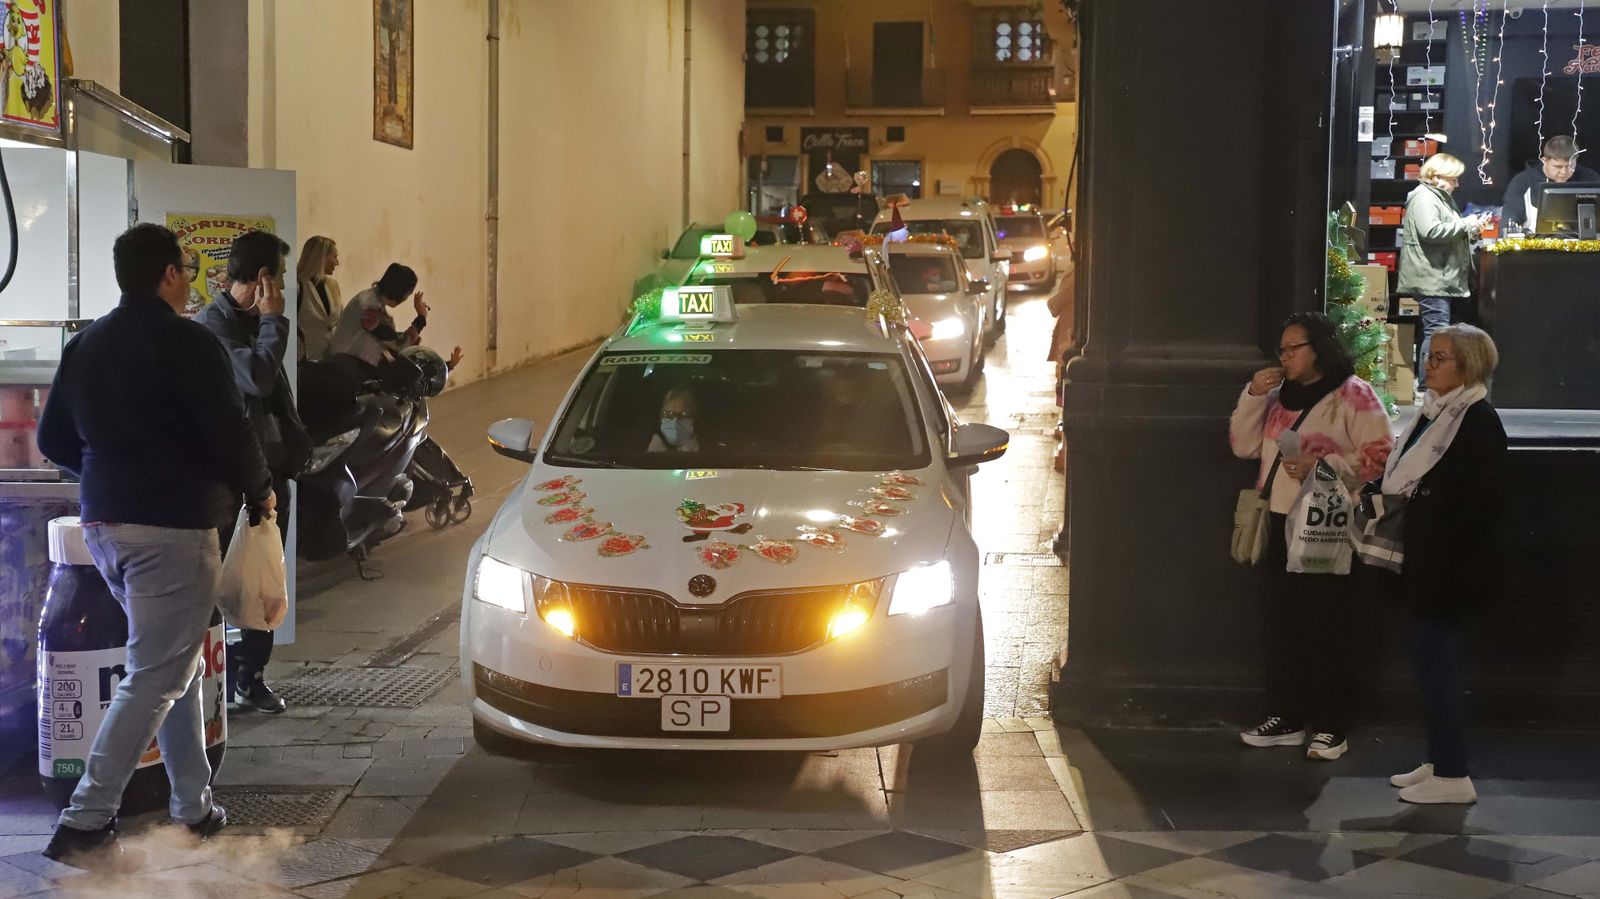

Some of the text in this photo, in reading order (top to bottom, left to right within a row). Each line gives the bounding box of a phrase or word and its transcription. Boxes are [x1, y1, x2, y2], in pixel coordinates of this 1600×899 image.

[712, 240, 732, 253] TAXI
[679, 293, 713, 313] TAXI
[604, 355, 709, 364] RADIO TAXI
[57, 682, 76, 692] 200
[622, 668, 773, 694] E 2810 KWF
[671, 700, 721, 727] SP
[56, 763, 75, 774] 750
